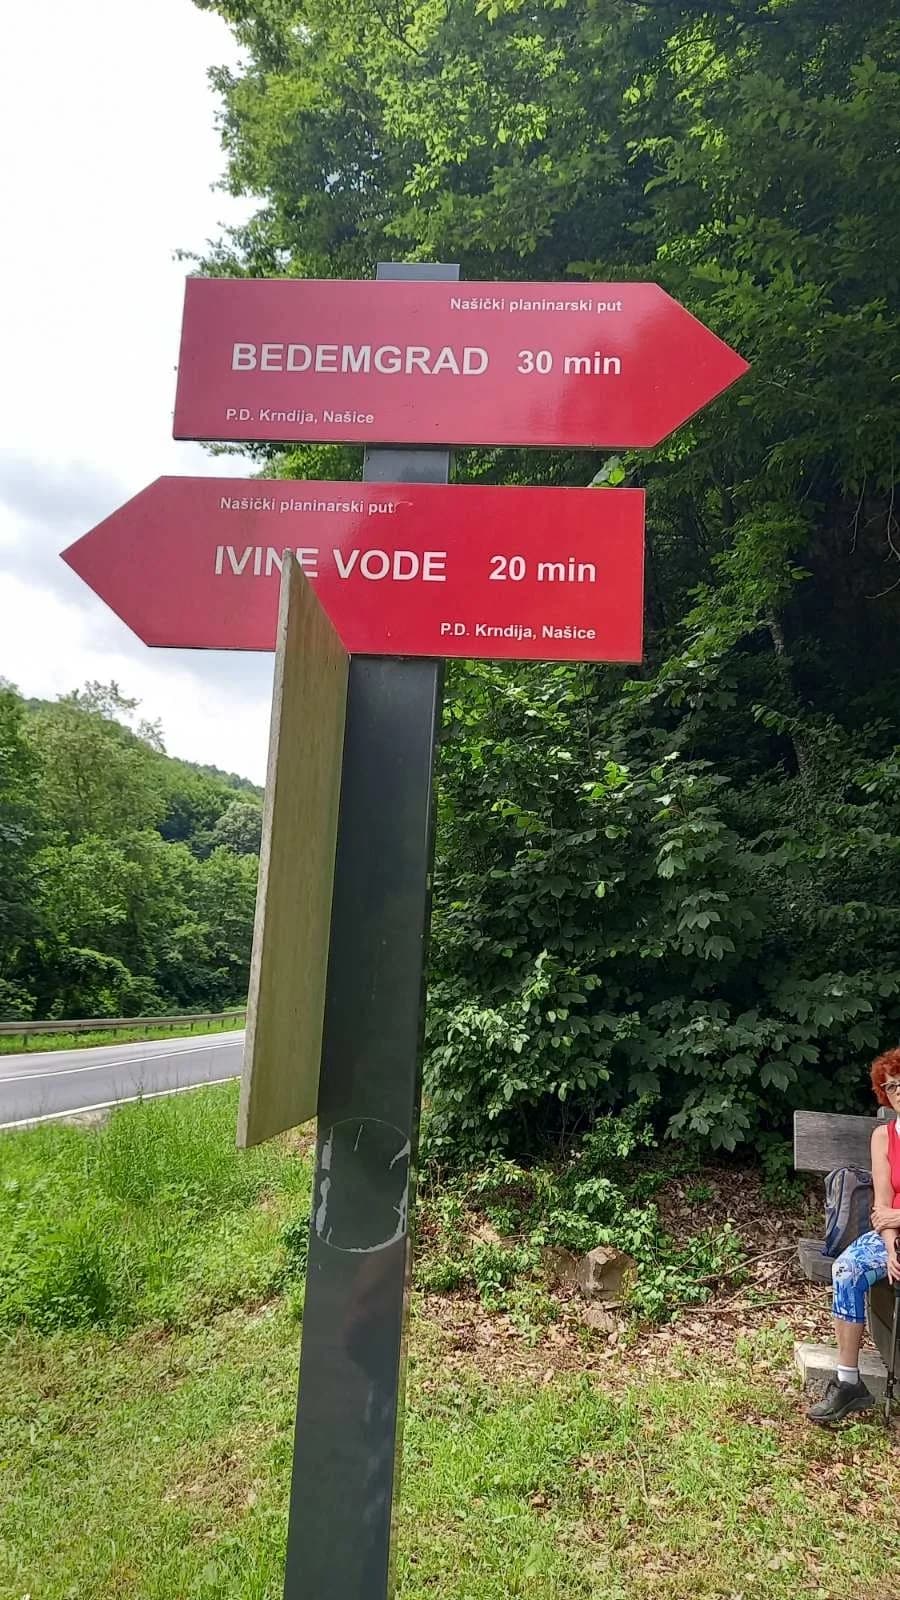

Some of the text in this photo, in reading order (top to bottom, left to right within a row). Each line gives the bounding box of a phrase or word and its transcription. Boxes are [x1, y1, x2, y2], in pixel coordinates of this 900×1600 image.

[450, 296, 622, 314] Našički planinarski put
[231, 342, 622, 376] BEDEMGRAD 30 min
[225, 408, 375, 425] P.D. Krndija, Našice
[220, 495, 395, 515] Našički planinarski put
[333, 549, 447, 581] VODE
[489, 554, 527, 581] 20
[537, 555, 597, 582] min
[440, 621, 596, 640] P.D. Krndija, Našice
